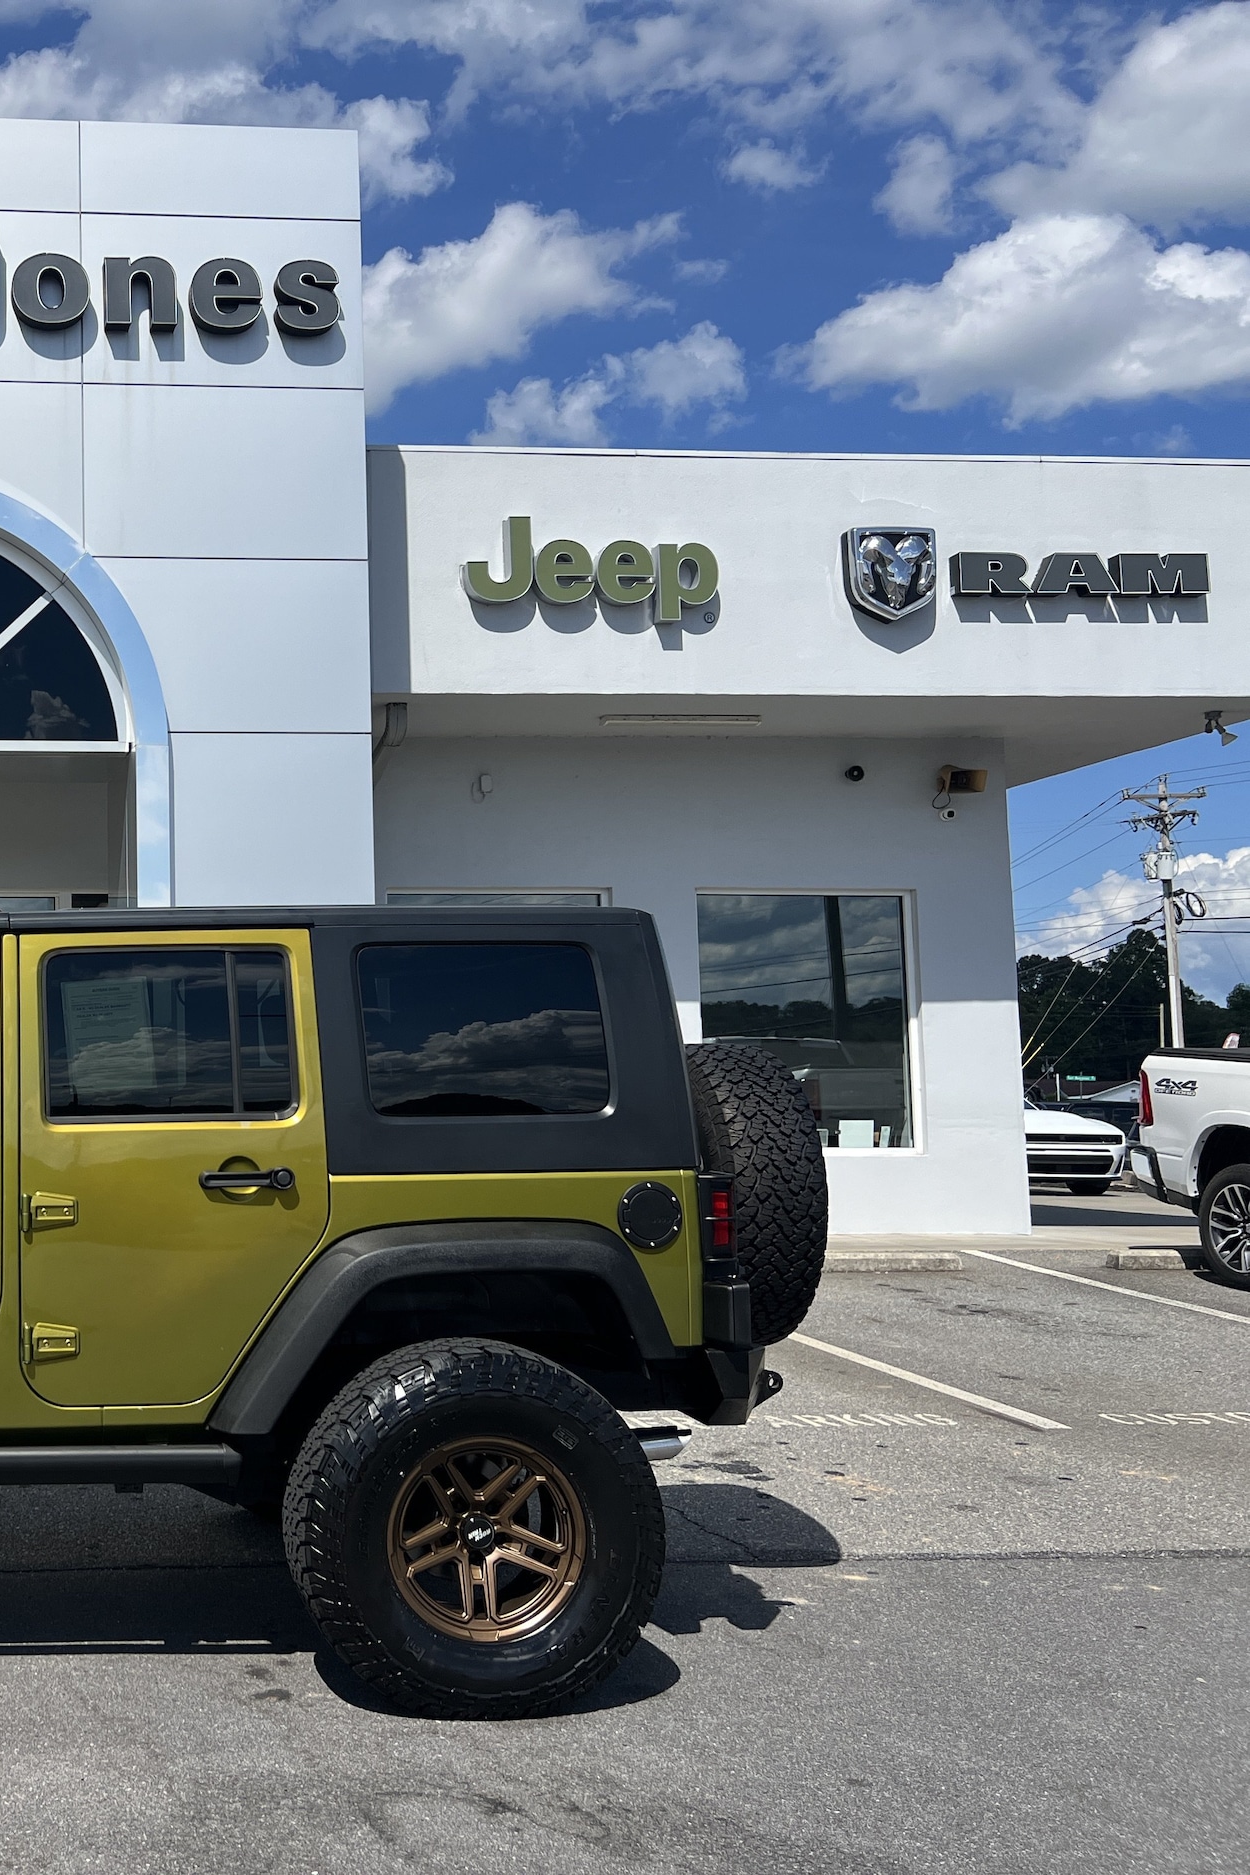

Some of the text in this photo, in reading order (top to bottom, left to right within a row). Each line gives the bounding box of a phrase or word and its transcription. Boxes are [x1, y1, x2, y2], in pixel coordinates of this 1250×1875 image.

[464, 515, 720, 622] Jeep
[952, 551, 1212, 598] RAM
[1155, 1078, 1198, 1091] 4x4
